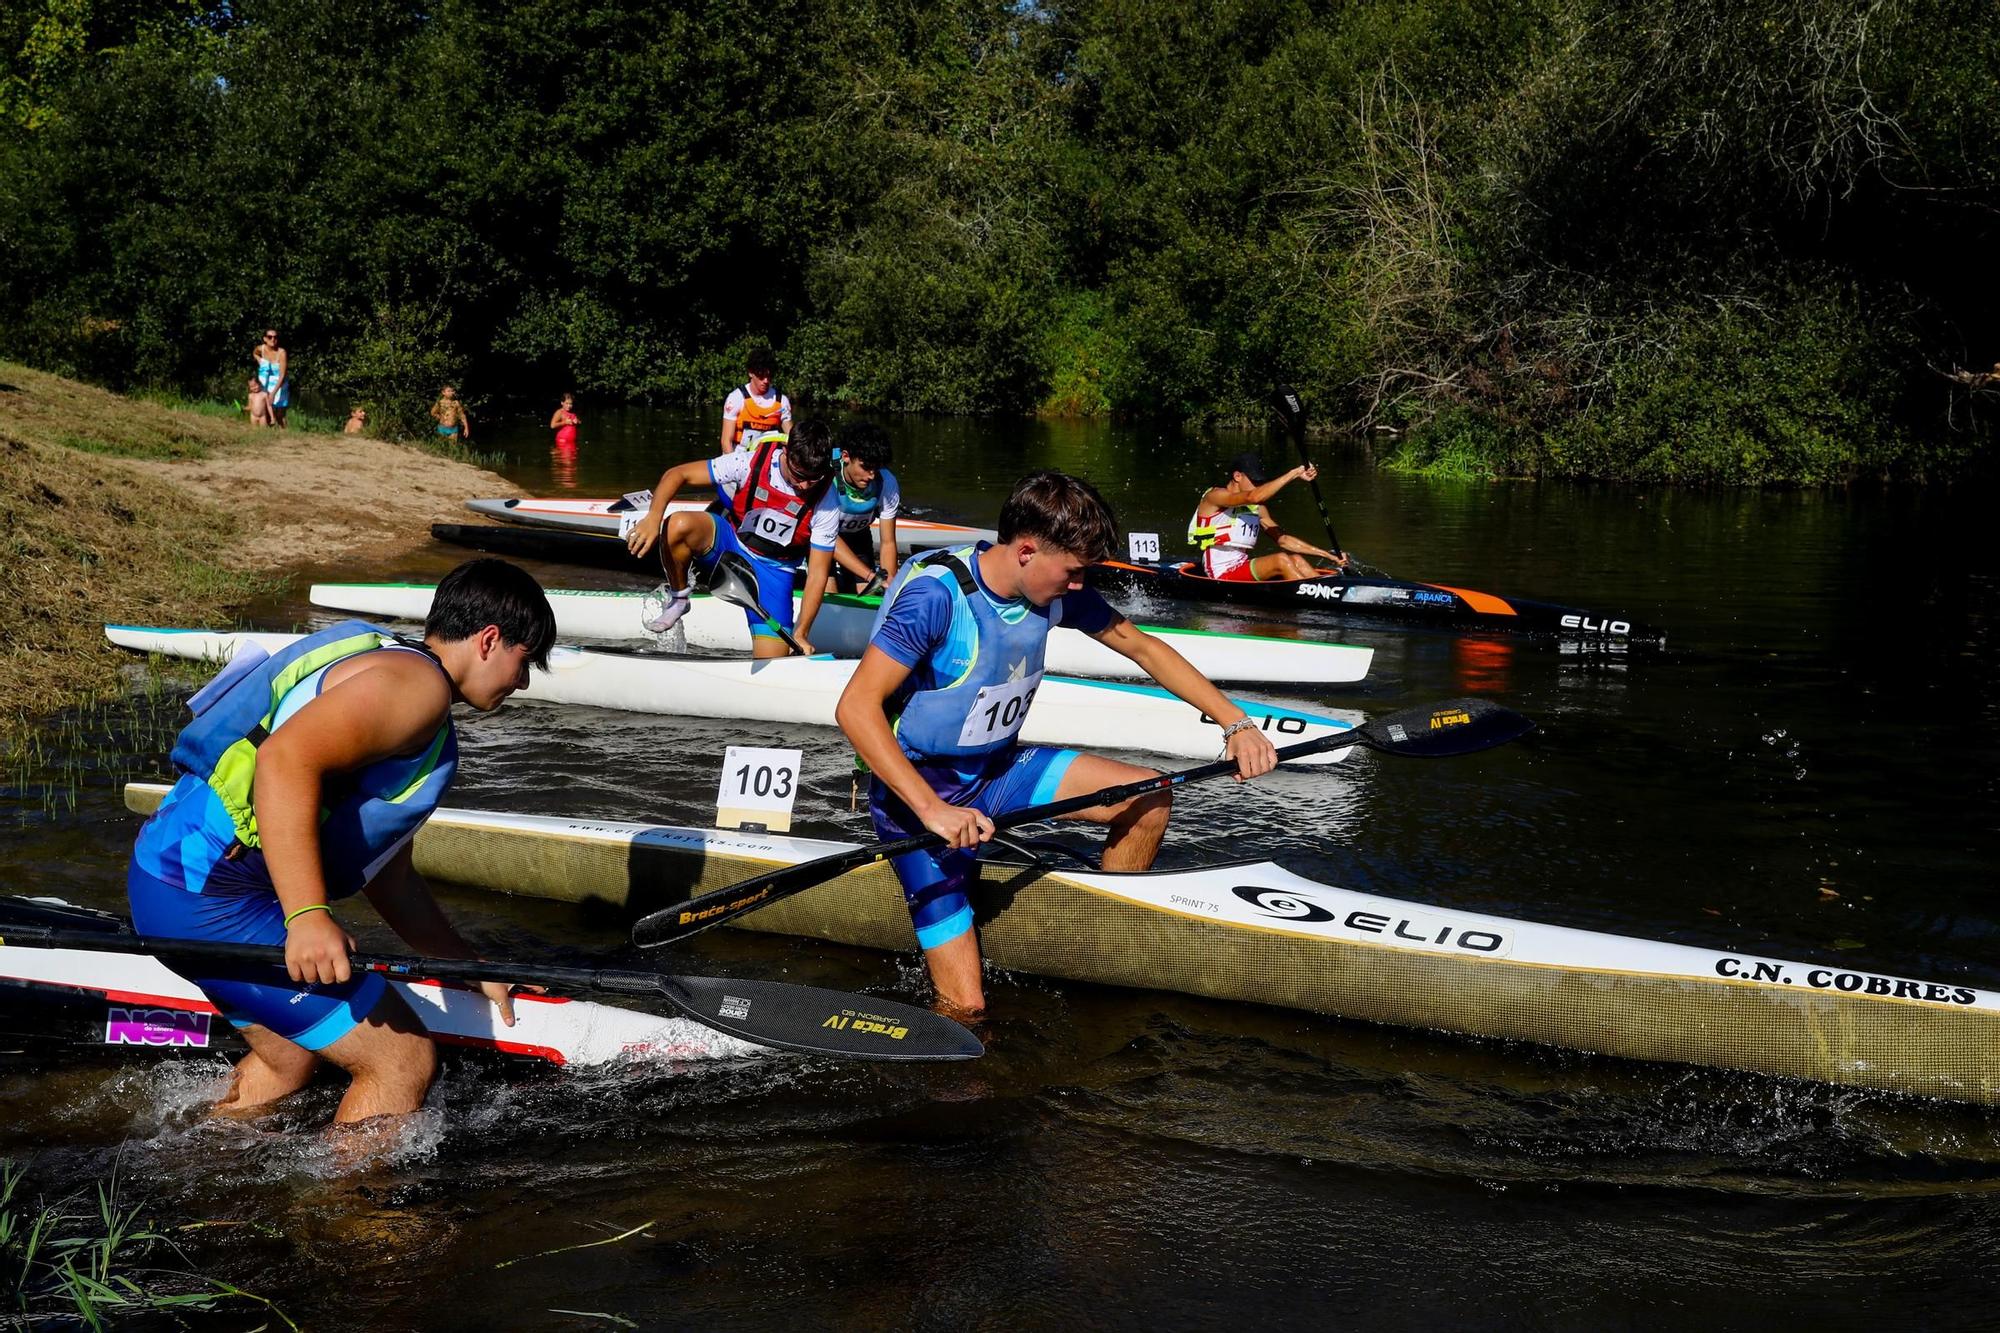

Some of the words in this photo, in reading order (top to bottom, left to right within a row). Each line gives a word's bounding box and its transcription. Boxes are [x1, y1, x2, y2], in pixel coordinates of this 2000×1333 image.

[752, 514, 792, 538] 107
[1241, 523, 1260, 537] 113
[1134, 540, 1158, 554] 113
[1295, 582, 1344, 600] SONIC
[1560, 614, 1631, 633] ELIO
[984, 687, 1036, 732] 103
[1200, 711, 1307, 734] IO
[1429, 716, 1442, 730] IV
[736, 763, 793, 799] 103
[568, 823, 774, 852] www.elio-kayaks.com
[1169, 894, 1205, 909] SPRINT
[1207, 902, 1220, 913] 75
[1344, 911, 1505, 952] ELIO
[1715, 957, 1792, 984] C.N.
[1806, 969, 1977, 1005] COBRES
[821, 1014, 849, 1031] IV
[857, 1011, 901, 1025] CARBON
